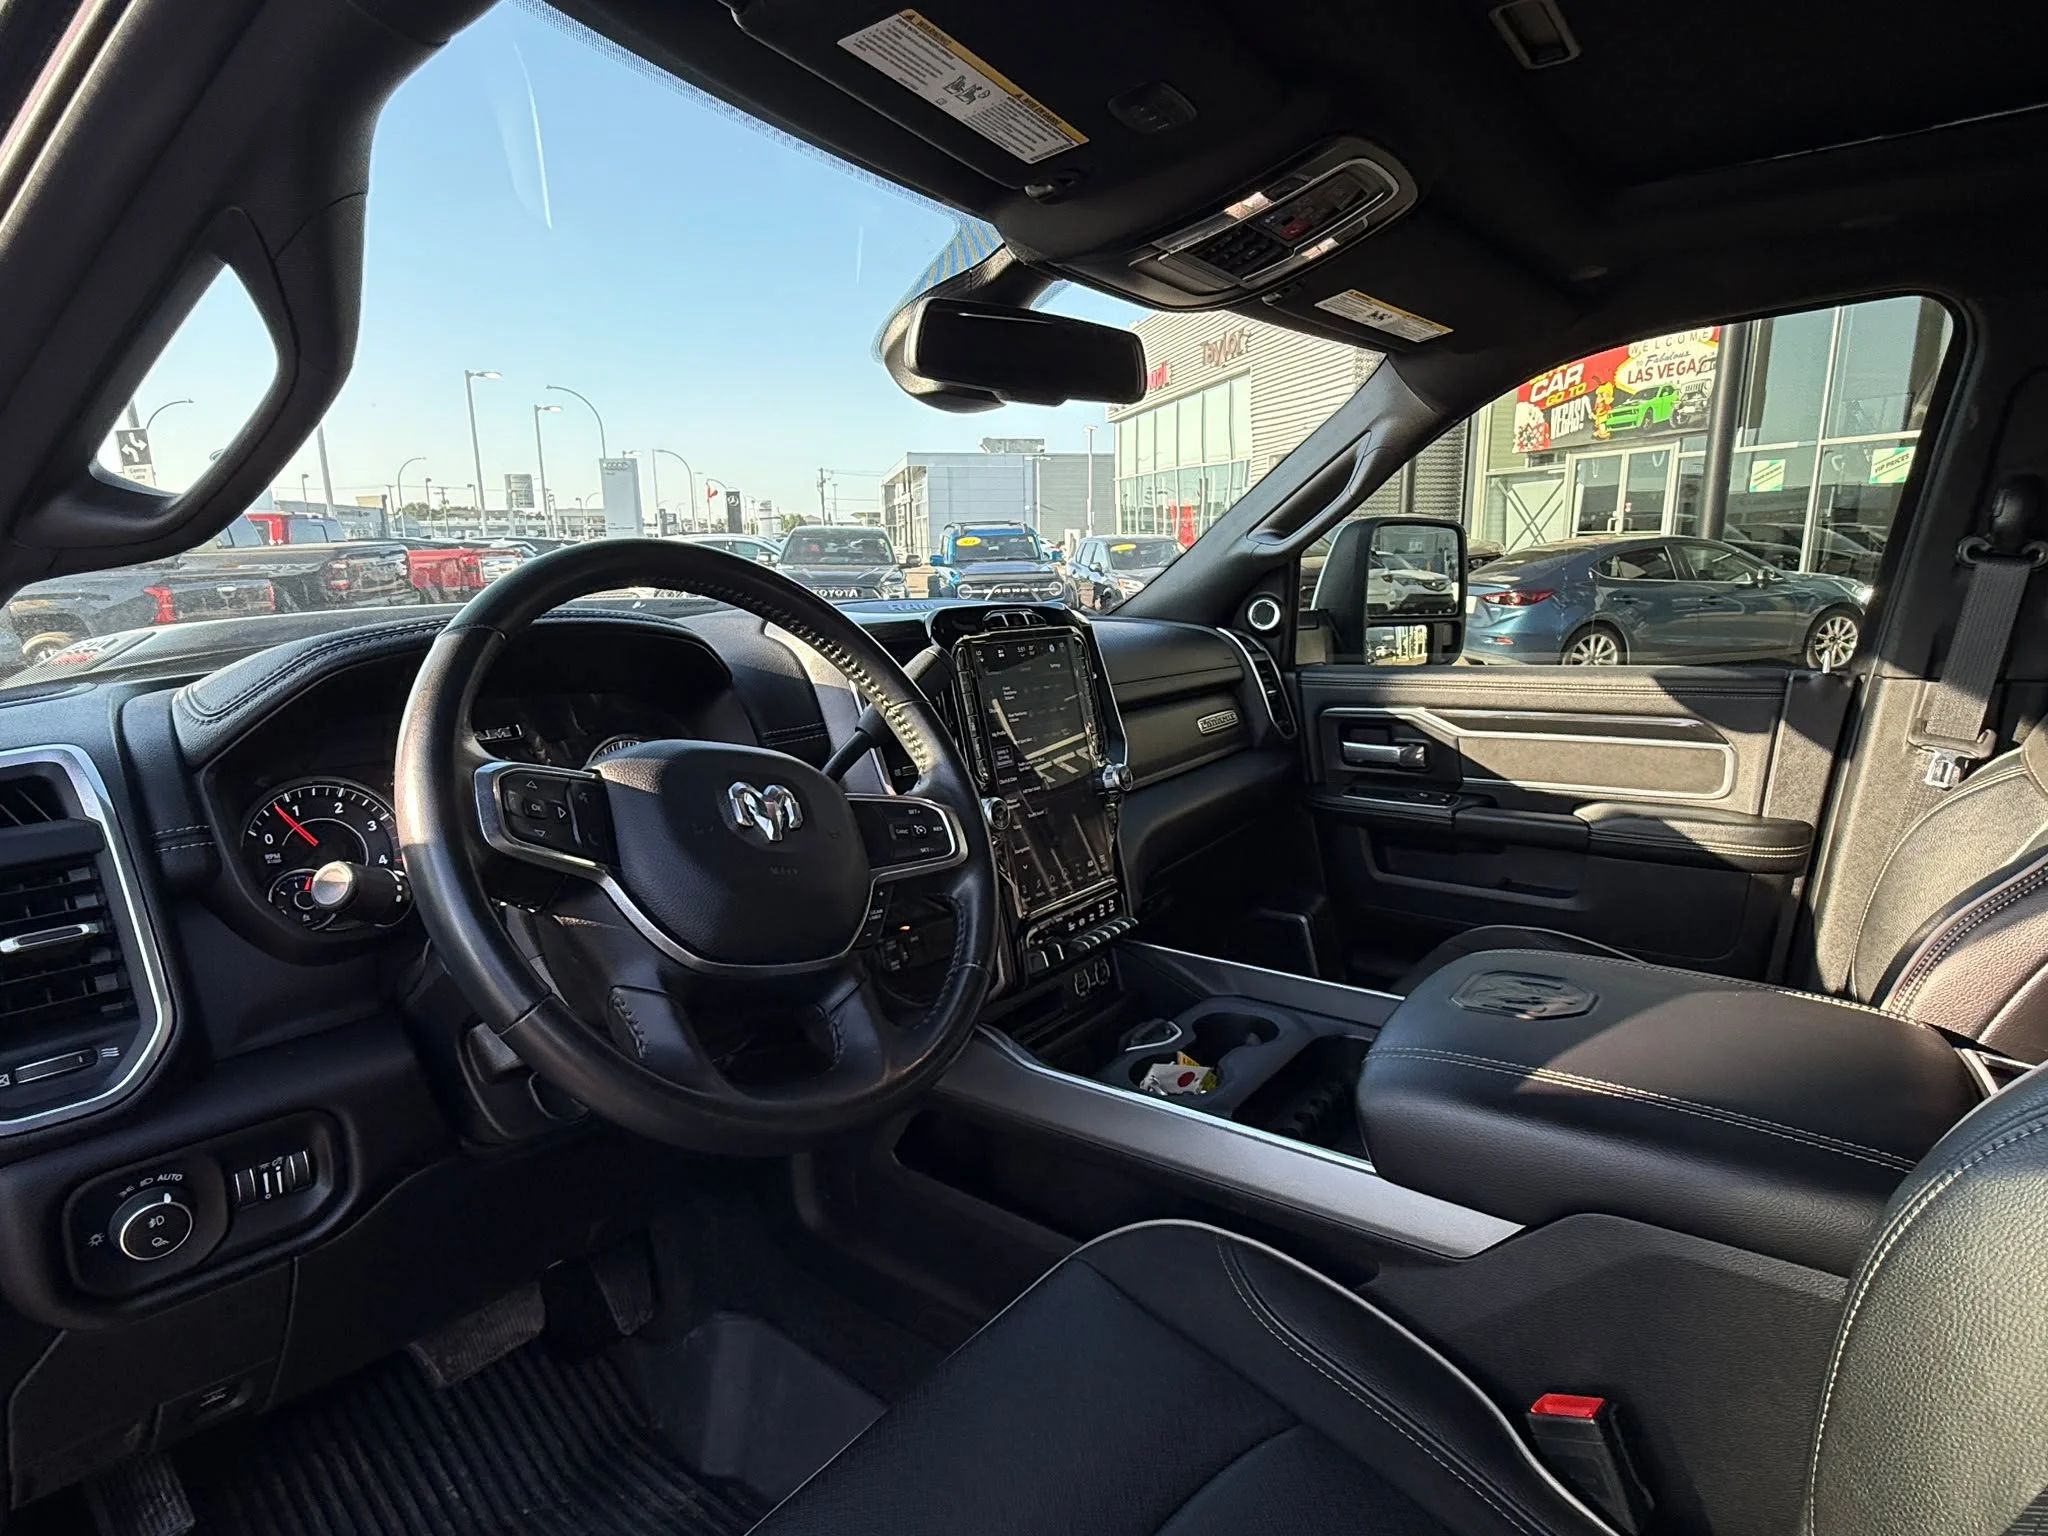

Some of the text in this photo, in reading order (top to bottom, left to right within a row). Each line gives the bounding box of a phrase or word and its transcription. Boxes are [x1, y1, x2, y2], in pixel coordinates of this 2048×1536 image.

[1200, 330, 1250, 368] Taylor
[1631, 331, 1709, 354] WELCOME
[1645, 350, 1691, 367] Fabulous
[1627, 358, 1700, 385] LAS VEGA
[1530, 363, 1585, 403] CAR
[1546, 382, 1587, 407] GO TO
[1550, 396, 1585, 440] VEGAS!
[292, 805, 300, 817] 1
[333, 802, 344, 814] 2
[367, 820, 377, 832] 3
[264, 833, 274, 845] 0
[378, 854, 388, 865] 4
[157, 1173, 183, 1182] AUTO
